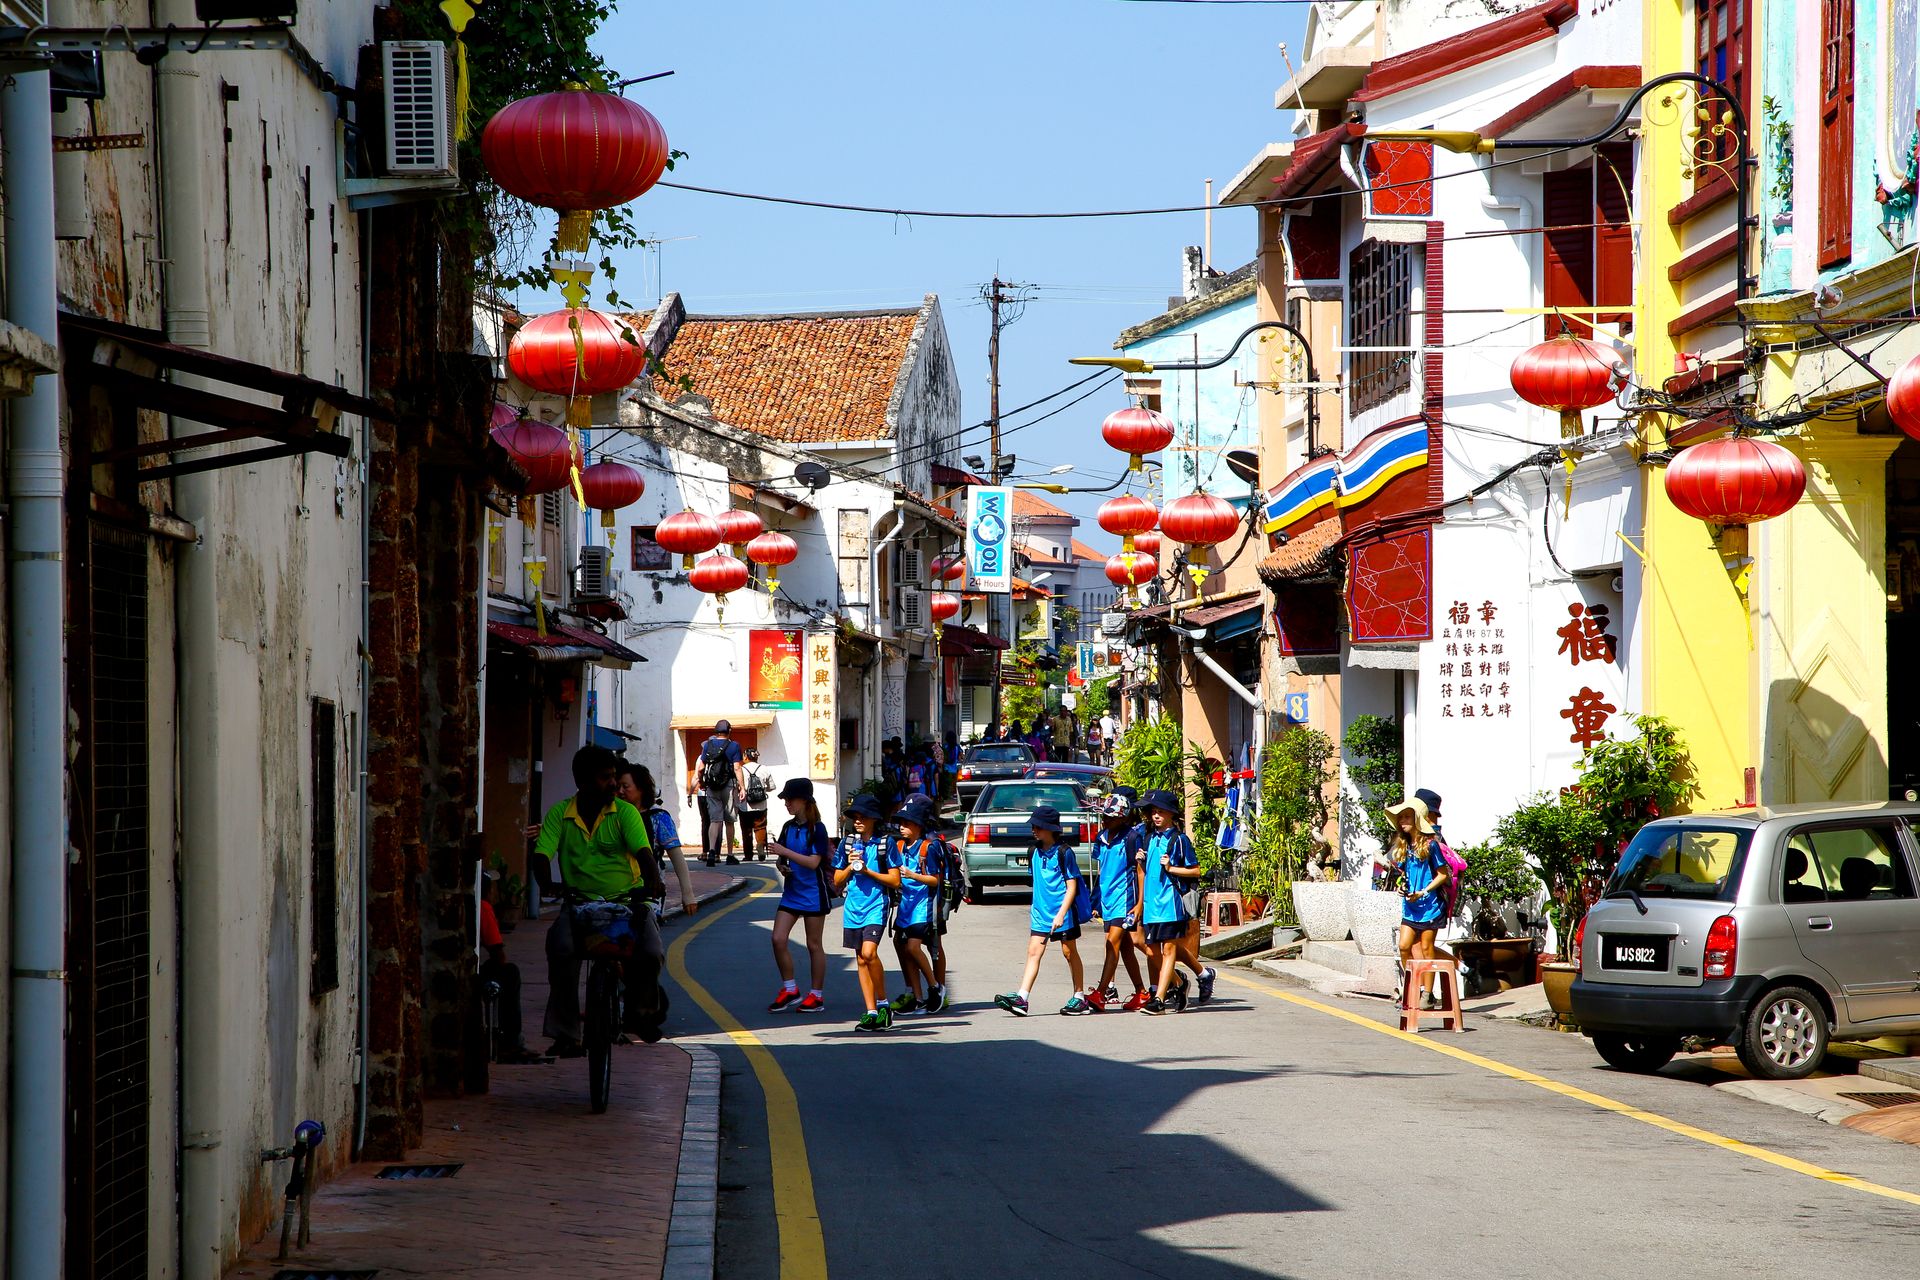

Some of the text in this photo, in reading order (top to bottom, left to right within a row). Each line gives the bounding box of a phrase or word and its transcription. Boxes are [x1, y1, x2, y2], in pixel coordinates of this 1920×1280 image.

[970, 578, 1004, 588] 24 Hours
[1448, 600, 1498, 626] 福章
[1557, 603, 1617, 806] 福章
